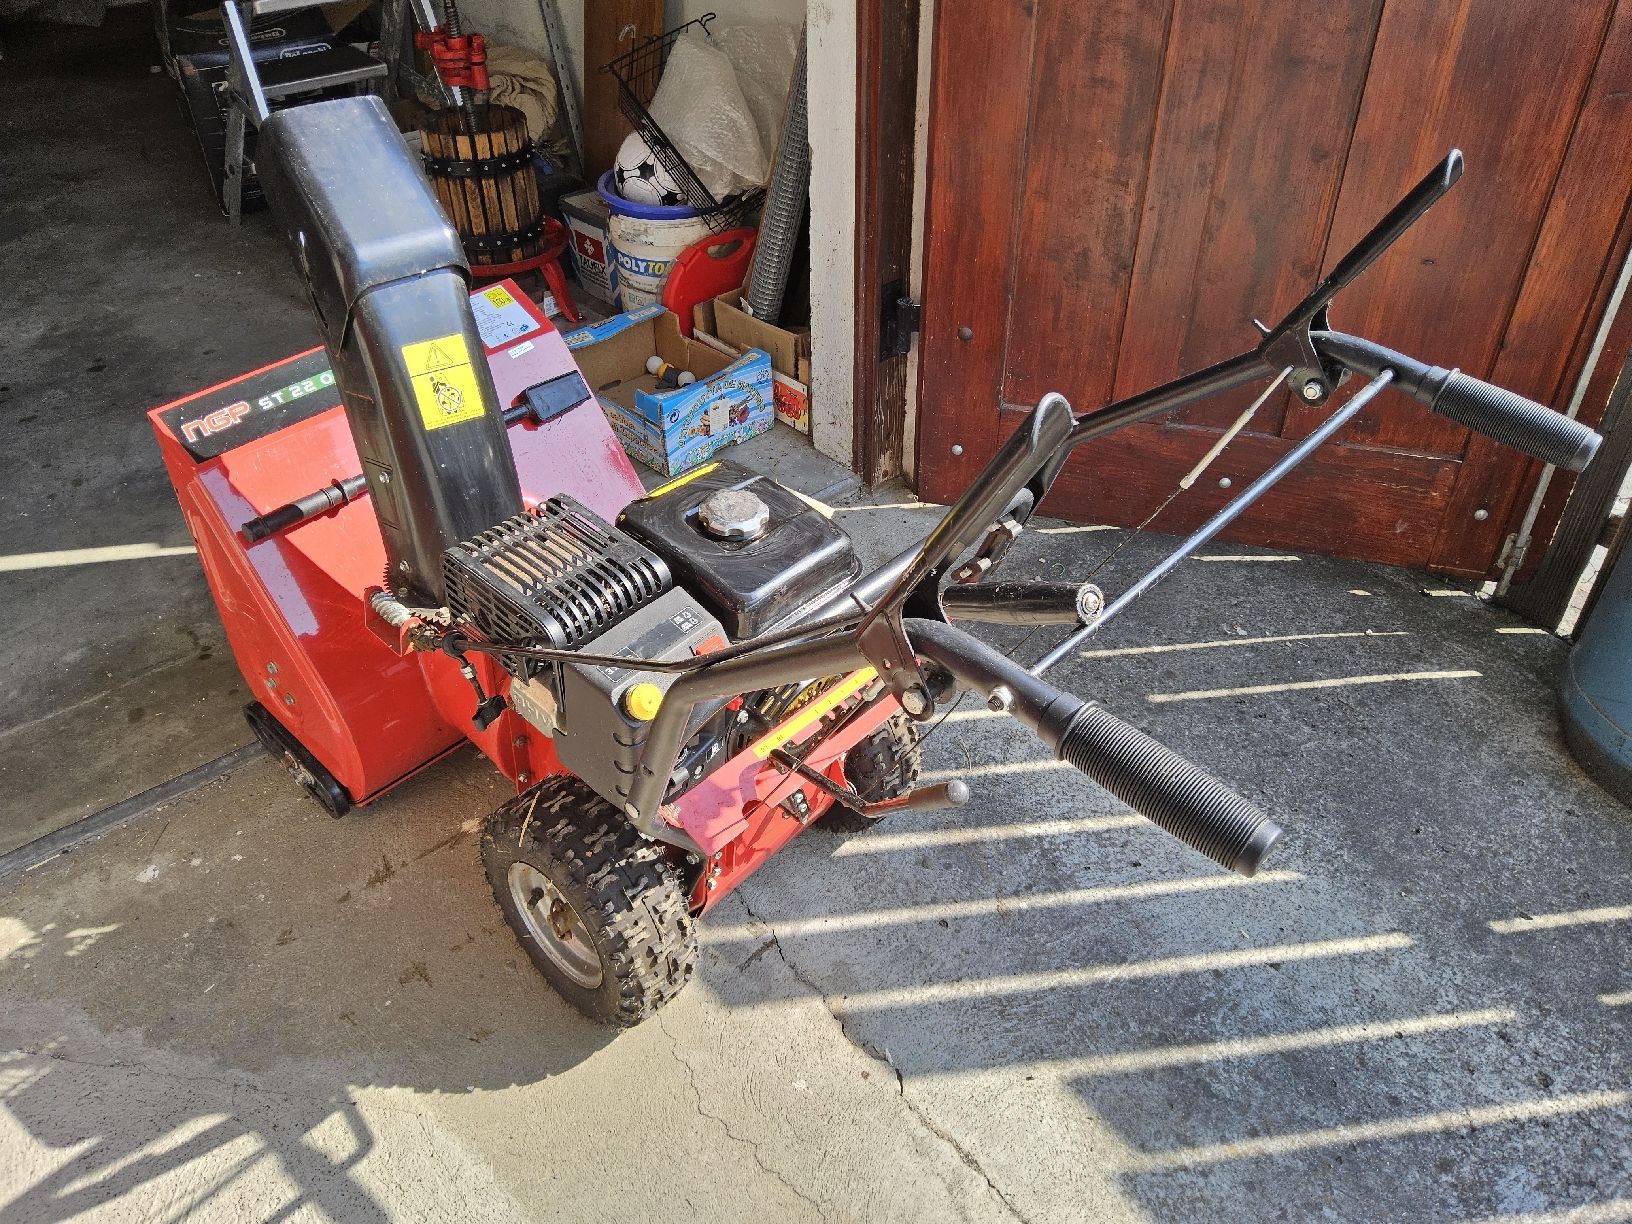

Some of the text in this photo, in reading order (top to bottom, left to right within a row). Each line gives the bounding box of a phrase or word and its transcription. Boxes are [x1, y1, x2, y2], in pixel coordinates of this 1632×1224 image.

[617, 252, 665, 275] POLYTO
[258, 391, 284, 411] ST
[288, 379, 316, 399] 22
